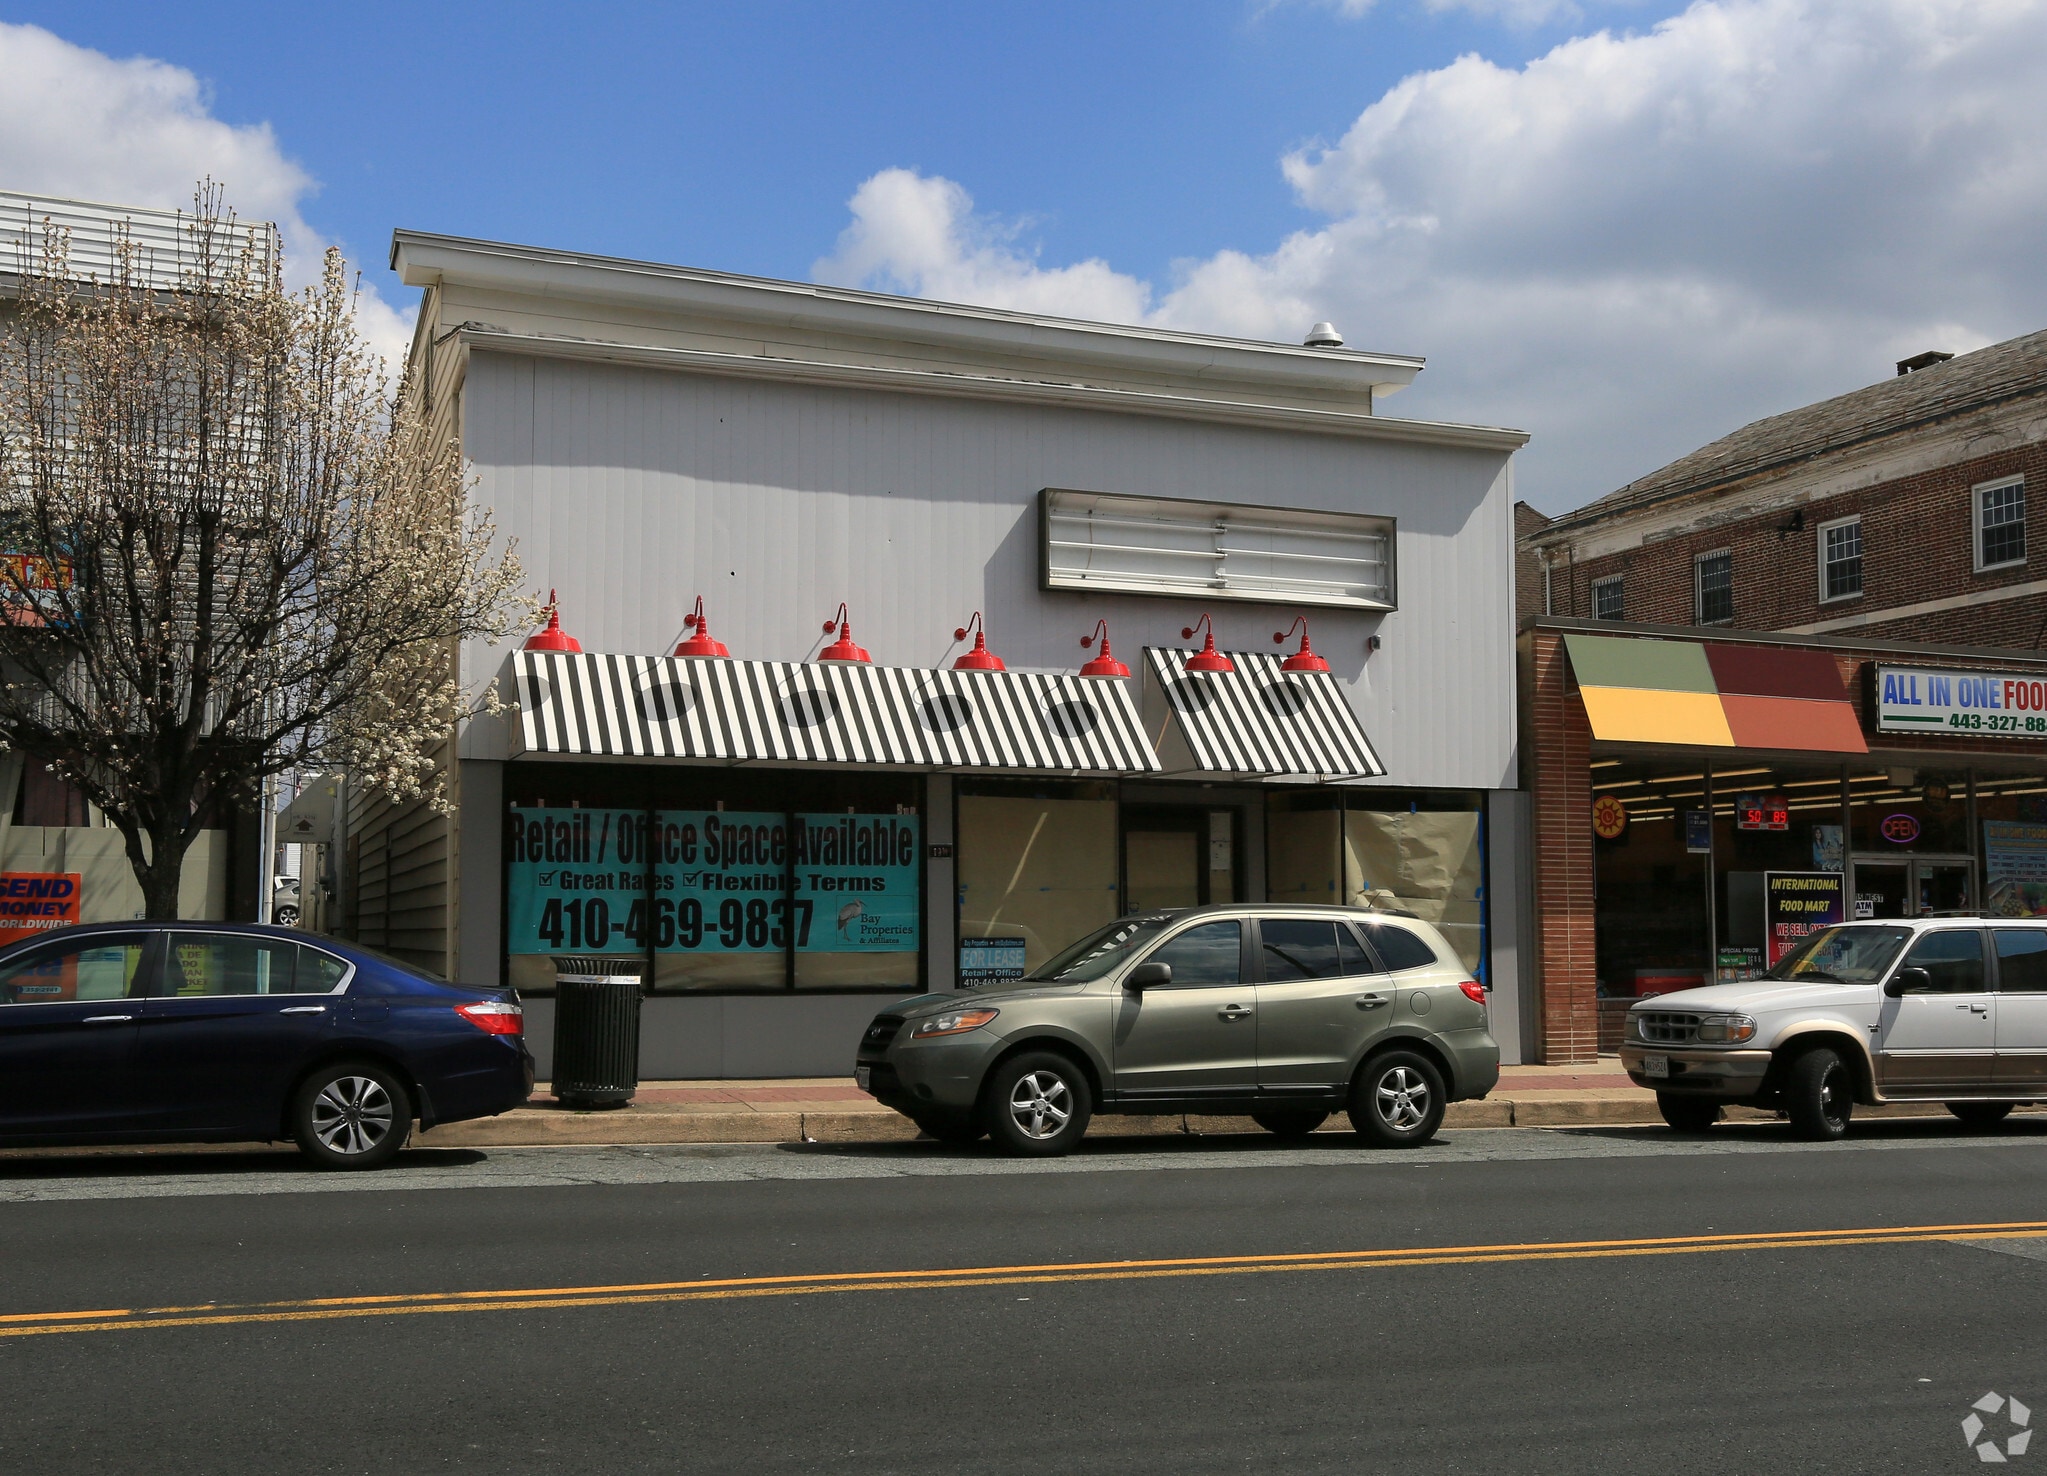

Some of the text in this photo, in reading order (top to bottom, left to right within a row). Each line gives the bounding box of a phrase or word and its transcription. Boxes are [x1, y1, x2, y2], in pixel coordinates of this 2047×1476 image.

[1883, 674, 2047, 712] ALL IN ONE FOO
[1949, 713, 2047, 732] 443-327-88
[1748, 810, 1787, 822] 50 89
[1884, 820, 1917, 836] OPEN
[508, 812, 591, 864] Retail
[617, 813, 697, 865] Ofice
[704, 814, 787, 870] Space
[791, 818, 914, 867] Available
[560, 871, 615, 890] Great
[807, 874, 886, 892] Terms
[1771, 878, 1839, 891] INTERNATIONAL
[1780, 900, 1830, 912] FOOD MART
[1855, 901, 1872, 910] ATM
[538, 897, 814, 949] 410-469-9837
[860, 913, 881, 926] Bay
[860, 925, 913, 937] Properties
[1776, 923, 1789, 936] WE
[1789, 923, 1809, 936] SELL
[963, 949, 1023, 967] FOR LEASE
[962, 969, 1021, 977] Retail Office
